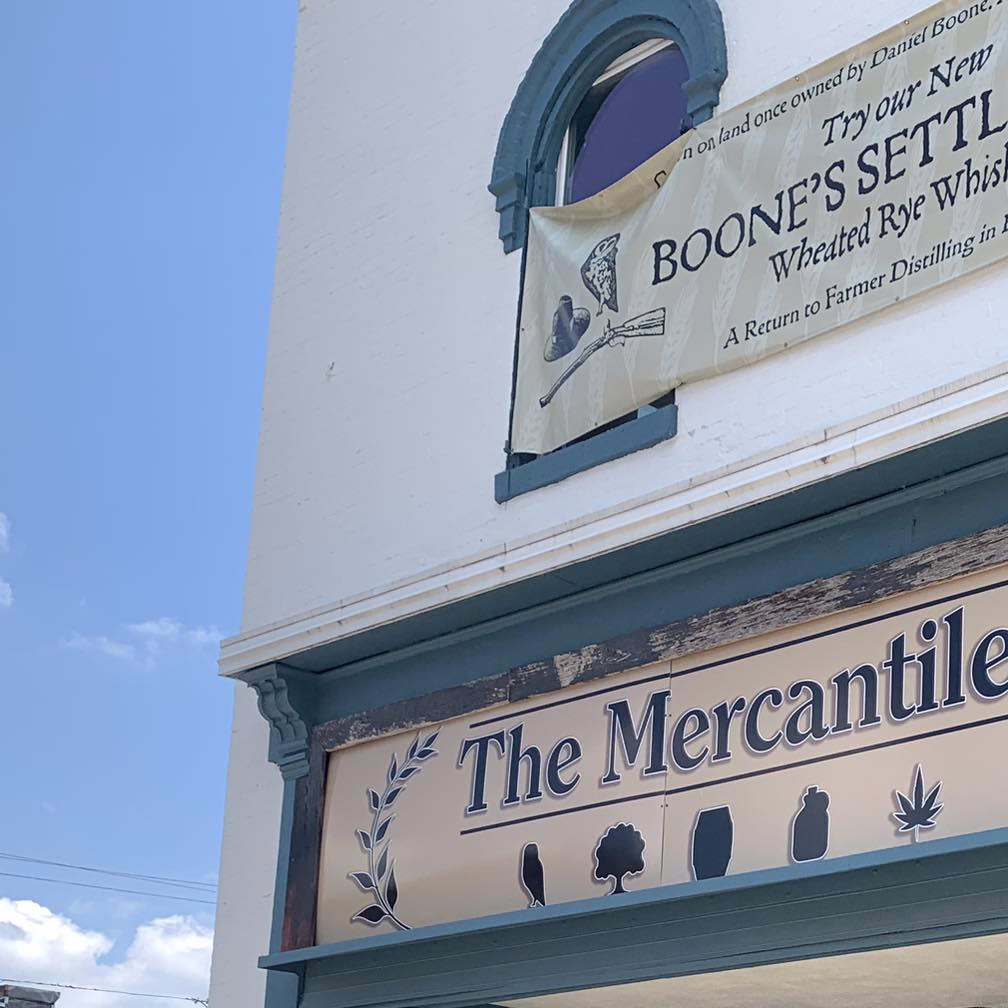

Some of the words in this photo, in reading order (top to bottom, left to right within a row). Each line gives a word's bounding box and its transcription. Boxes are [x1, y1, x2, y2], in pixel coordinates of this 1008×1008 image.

[697, 134, 717, 155] on
[719, 111, 751, 147] land
[754, 100, 788, 129] once
[791, 73, 843, 109] owned
[846, 58, 869, 86] by
[870, 32, 928, 77] Daniel
[931, 0, 993, 39] Boone.
[822, 106, 874, 148] Try
[874, 79, 923, 123] our
[927, 43, 997, 98] New
[651, 159, 847, 287] BOONE'S
[769, 218, 872, 285] Wheated
[877, 191, 926, 243] Rye
[723, 325, 741, 350] A
[744, 307, 801, 343] Return
[803, 297, 821, 320] to
[824, 273, 887, 312] Farmer
[889, 233, 976, 287] Distilling
[979, 224, 998, 250] in
[459, 723, 581, 818] The
